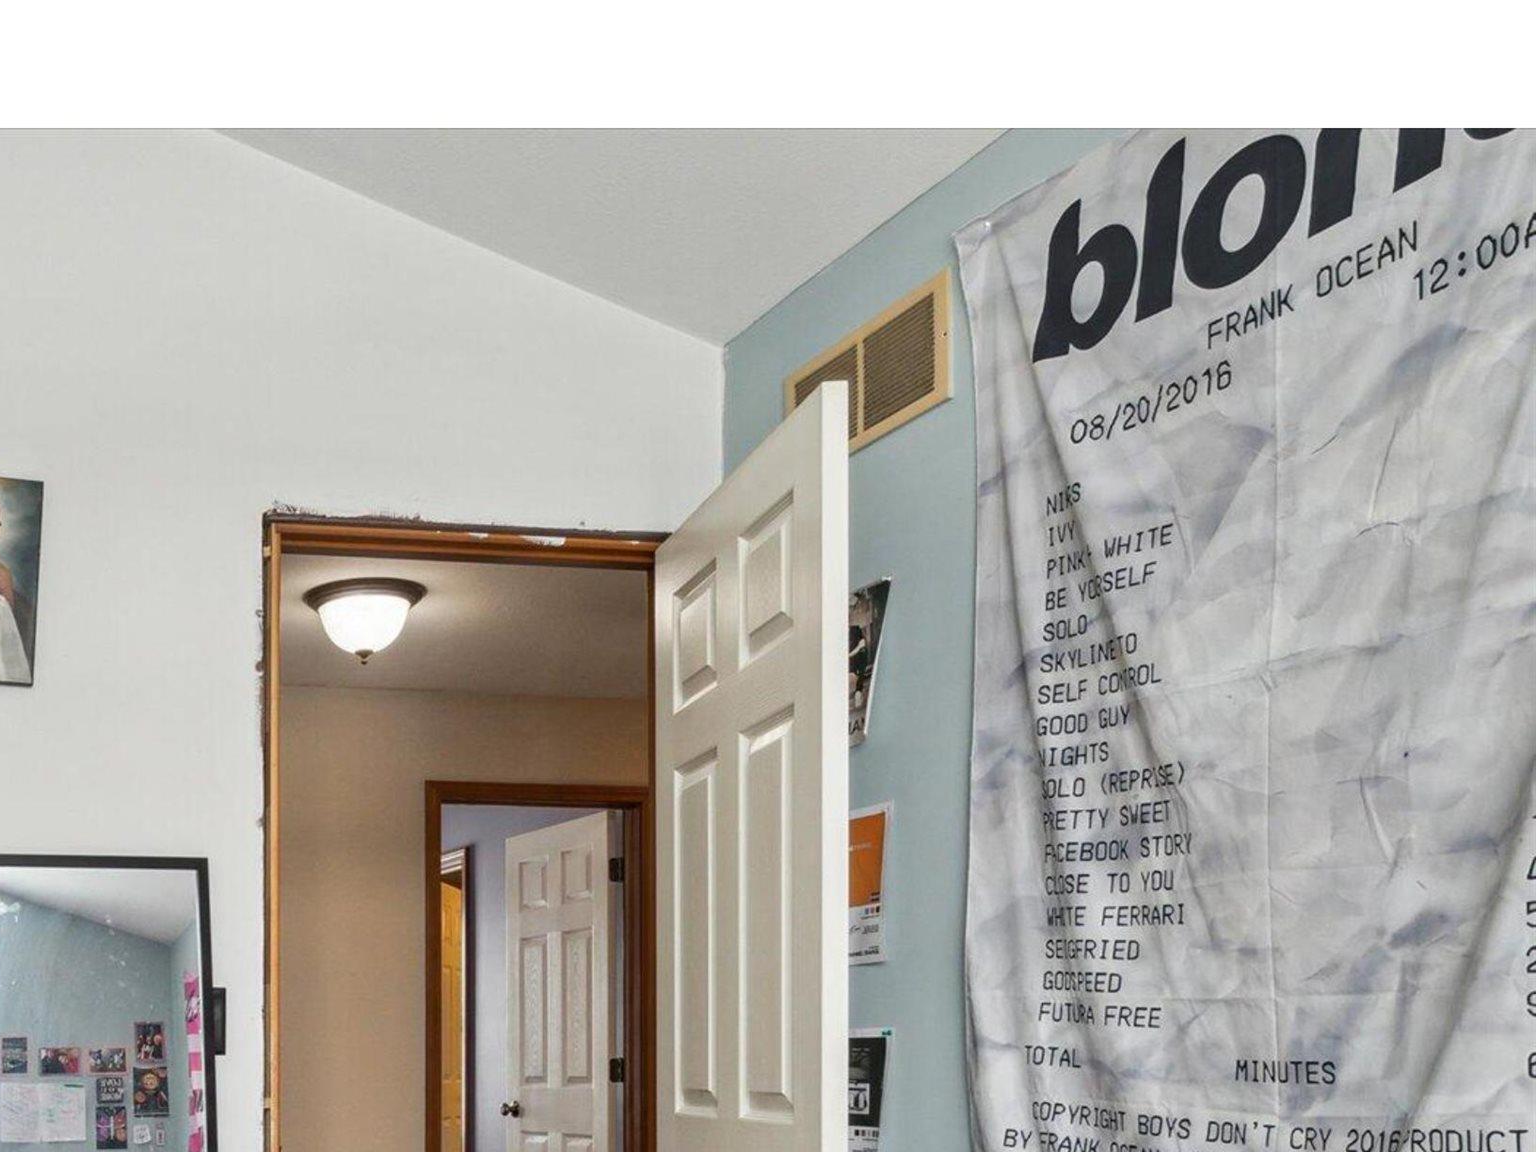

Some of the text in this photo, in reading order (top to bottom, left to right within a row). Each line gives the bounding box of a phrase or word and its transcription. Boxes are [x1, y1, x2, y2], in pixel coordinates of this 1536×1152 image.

[1033, 128, 1516, 363] blon
[1208, 220, 1419, 349] FRANK OCEAN
[1070, 360, 1232, 444] 08/20/2016
[1048, 520, 1075, 547] IVY
[1104, 523, 1174, 558] WHITE
[1045, 588, 1067, 611] BE
[1043, 614, 1088, 642] SOLO
[1037, 679, 1088, 704] SELF
[1036, 704, 1131, 737] GOOD GUY
[1100, 760, 1185, 795] (REPRISE)
[1119, 800, 1171, 826] SWEET
[1140, 832, 1192, 858] STORY
[1045, 870, 1174, 895] CLOSE TO YOU
[1047, 903, 1184, 926] WHITE FERRARI
[1043, 971, 1122, 993] GODSPEED
[1038, 1002, 1161, 1028] FUTURA FREE
[1025, 1045, 1081, 1068] TOTAL
[1235, 1059, 1336, 1085] MINUTES
[1003, 1128, 1032, 1149] BY
[1032, 1101, 1126, 1131] COPYRIGHT
[1138, 1115, 1191, 1140] BOYS
[1206, 1121, 1276, 1148] DON'T
[1289, 1127, 1332, 1151] CRY
